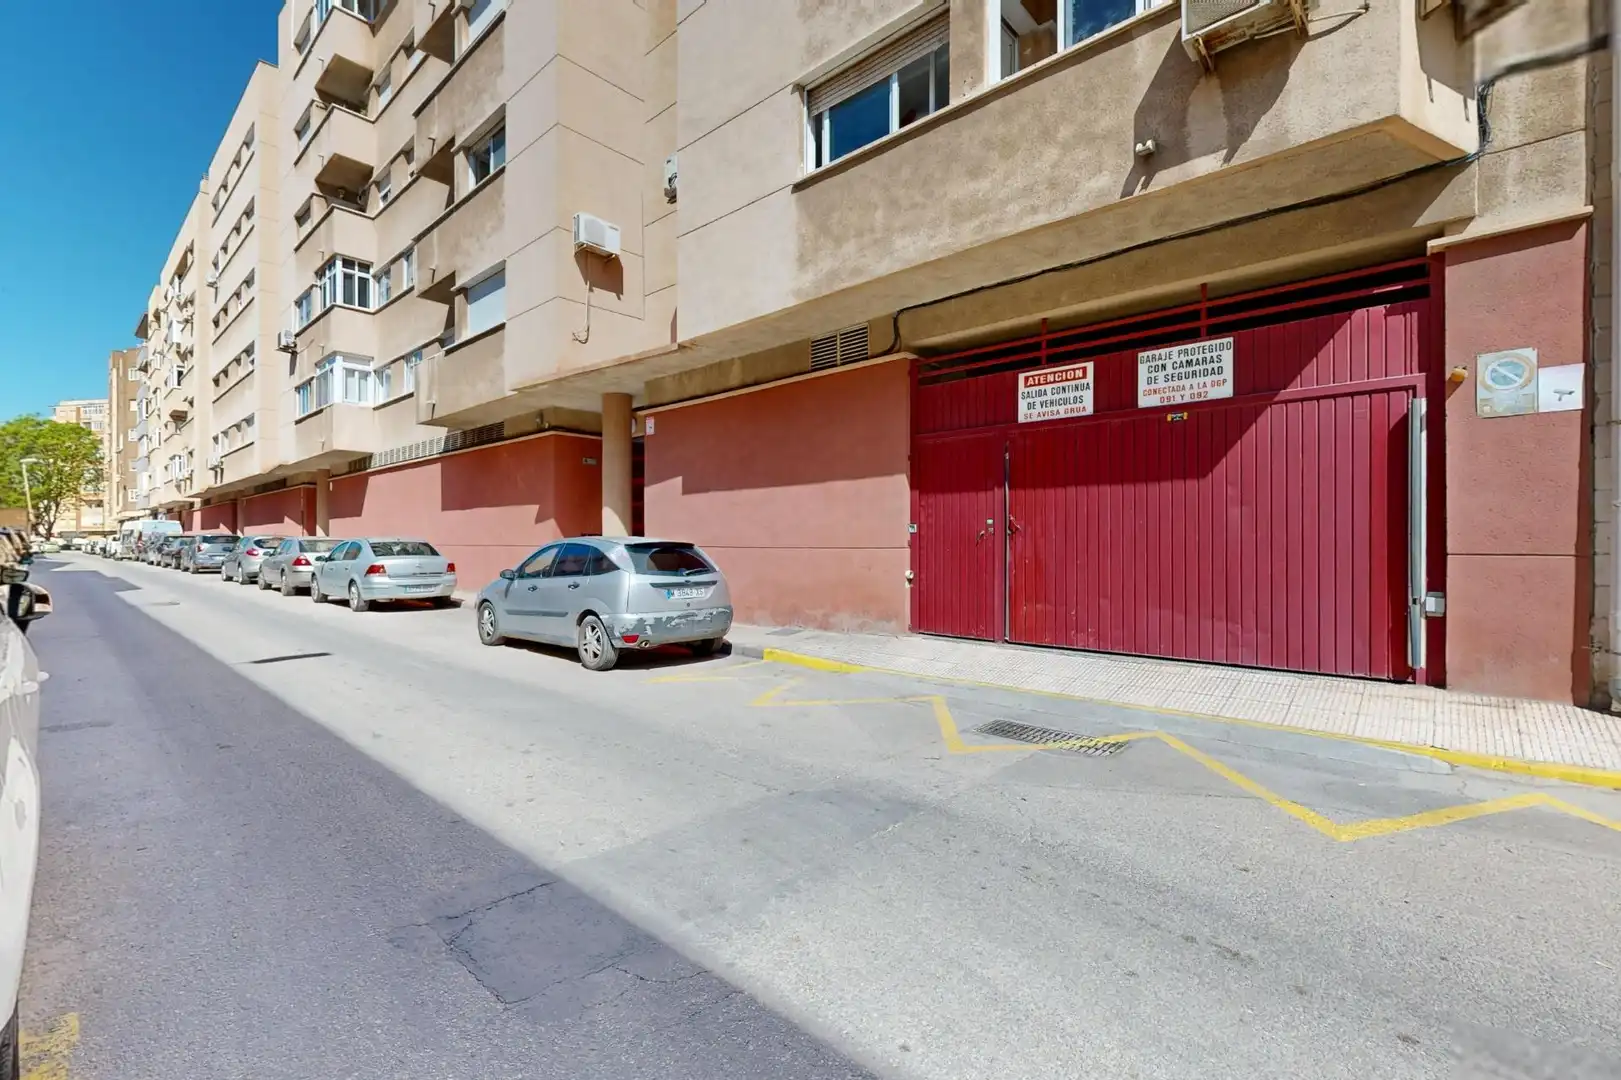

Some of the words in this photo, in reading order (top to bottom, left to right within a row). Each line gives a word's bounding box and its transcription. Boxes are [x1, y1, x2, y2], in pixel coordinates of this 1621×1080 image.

[1139, 350, 1174, 365] GARAJE
[1177, 340, 1232, 358] PROTEGIDO
[1147, 363, 1167, 374] CON
[1172, 354, 1223, 371] CAMARAS
[1026, 368, 1084, 386] ATENCION
[1146, 374, 1160, 386] DE
[1163, 365, 1224, 383] SEGURIDAD
[1021, 388, 1048, 400] SALIDA
[1050, 382, 1091, 396] CONTINUA
[1142, 384, 1186, 397] CONECTADA
[1188, 383, 1194, 391] A
[1197, 381, 1208, 390] LA
[1159, 395, 1176, 404] 091
[1180, 393, 1185, 401] Y
[1189, 390, 1209, 400] 092
[1027, 401, 1037, 411] DE
[1039, 395, 1084, 409] VEHICULOS
[1036, 409, 1061, 418] AVISA
[1063, 406, 1087, 415] GRUA
